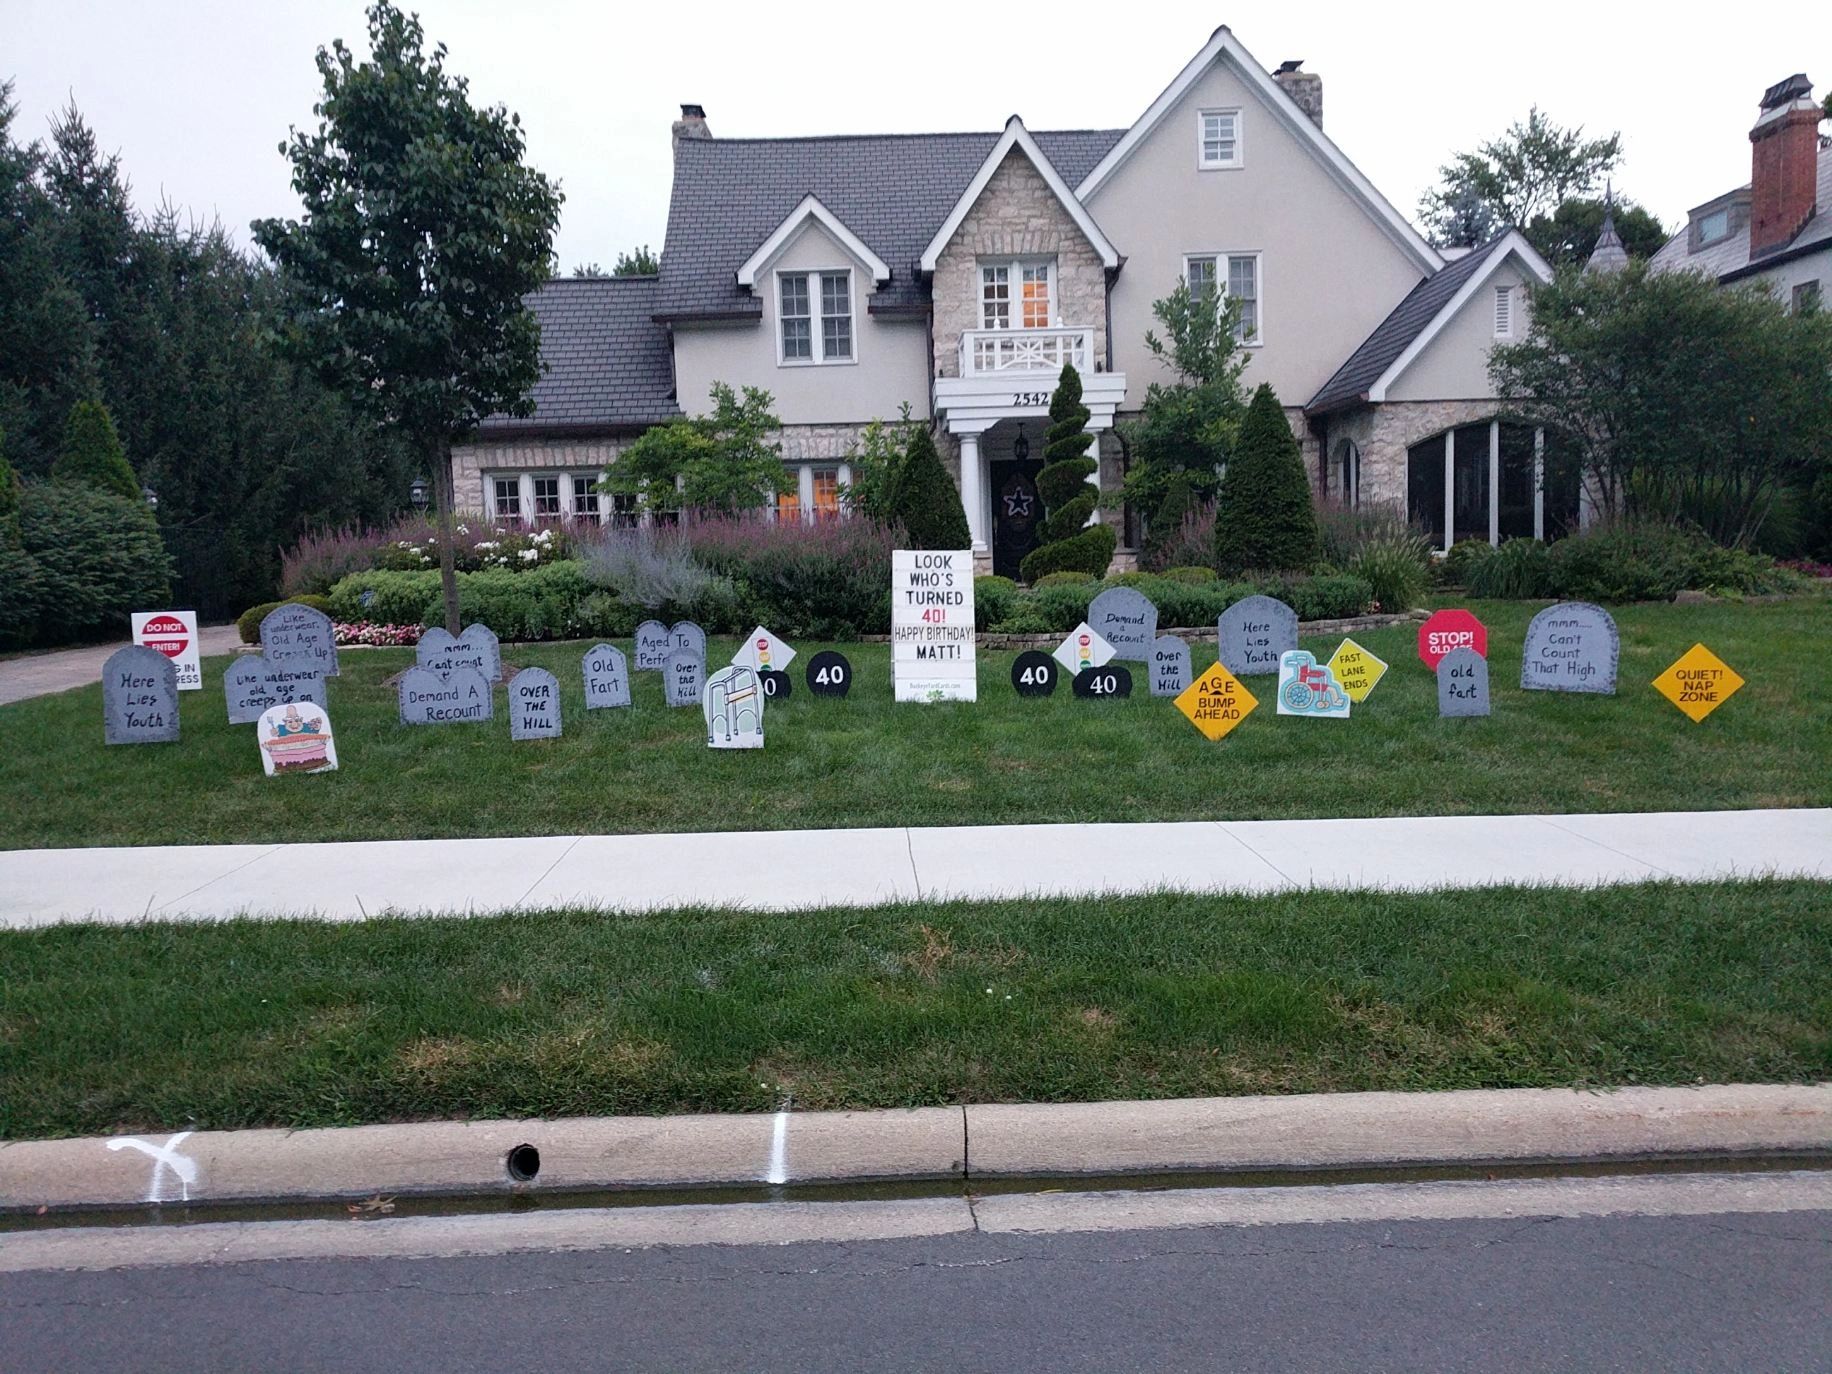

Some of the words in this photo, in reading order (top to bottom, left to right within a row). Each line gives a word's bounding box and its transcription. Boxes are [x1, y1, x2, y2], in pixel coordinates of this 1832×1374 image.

[1013, 392, 1049, 406] 2542
[915, 554, 952, 569] LOOK
[910, 573, 953, 586] WHO'S
[906, 590, 964, 605] TURNED
[283, 615, 304, 623] Like
[922, 609, 946, 622] 40!
[146, 624, 162, 632] DO
[163, 623, 182, 632] NOT
[1105, 614, 1145, 630] Demand
[1244, 622, 1270, 632] Here
[895, 626, 924, 640] HAPPY
[926, 626, 974, 640] BIRTHDAY!
[1106, 634, 1145, 644] Recount
[1428, 632, 1474, 645] STOP!
[1550, 634, 1582, 644] Can't
[152, 642, 180, 651] ENTER!
[272, 635, 289, 645] Old
[297, 633, 318, 648] Age
[642, 636, 670, 652] Aged
[676, 634, 690, 648] To
[1247, 638, 1270, 647] Lies
[315, 648, 328, 660] Up
[917, 644, 960, 659] MATT!
[1430, 645, 1450, 654] OLD
[1542, 648, 1580, 658] Count
[1156, 651, 1182, 661] Over
[1244, 651, 1278, 664] Youth
[1340, 653, 1361, 664] FAST
[184, 664, 195, 672] IN
[592, 660, 614, 672] Old
[676, 664, 698, 673] Over
[1160, 664, 1179, 675] the
[1342, 666, 1366, 677] LANE
[1451, 664, 1474, 678] old
[1532, 661, 1560, 674] That
[1568, 662, 1596, 681] High
[121, 672, 154, 688] Here
[237, 674, 256, 685] Like
[265, 670, 318, 682] underwear
[679, 675, 694, 684] the
[815, 666, 844, 685] 40
[1020, 666, 1048, 684] 40
[1676, 670, 1722, 680] QUIET!
[250, 686, 266, 696] old
[276, 685, 295, 696] age
[590, 678, 620, 694] Fart
[764, 678, 776, 696] 0
[1090, 675, 1117, 694] 40
[1158, 679, 1181, 690] Hill
[1199, 676, 1234, 693] AGE
[1344, 680, 1368, 690] ENDS
[1448, 683, 1476, 698] fart
[1684, 681, 1714, 690] NAP
[409, 686, 459, 703] Demand
[468, 685, 479, 698] A
[520, 686, 550, 698] OVER
[1680, 692, 1718, 702] ZONE
[126, 693, 158, 706] Lies
[240, 696, 276, 708] creeps
[282, 696, 294, 704] up
[300, 694, 313, 702] on
[1198, 698, 1236, 708] BUMP
[426, 703, 482, 720] Recount
[525, 700, 546, 712] THE
[124, 712, 164, 728] Youth
[1194, 710, 1240, 720] AHEAD
[524, 717, 552, 729] HILL
